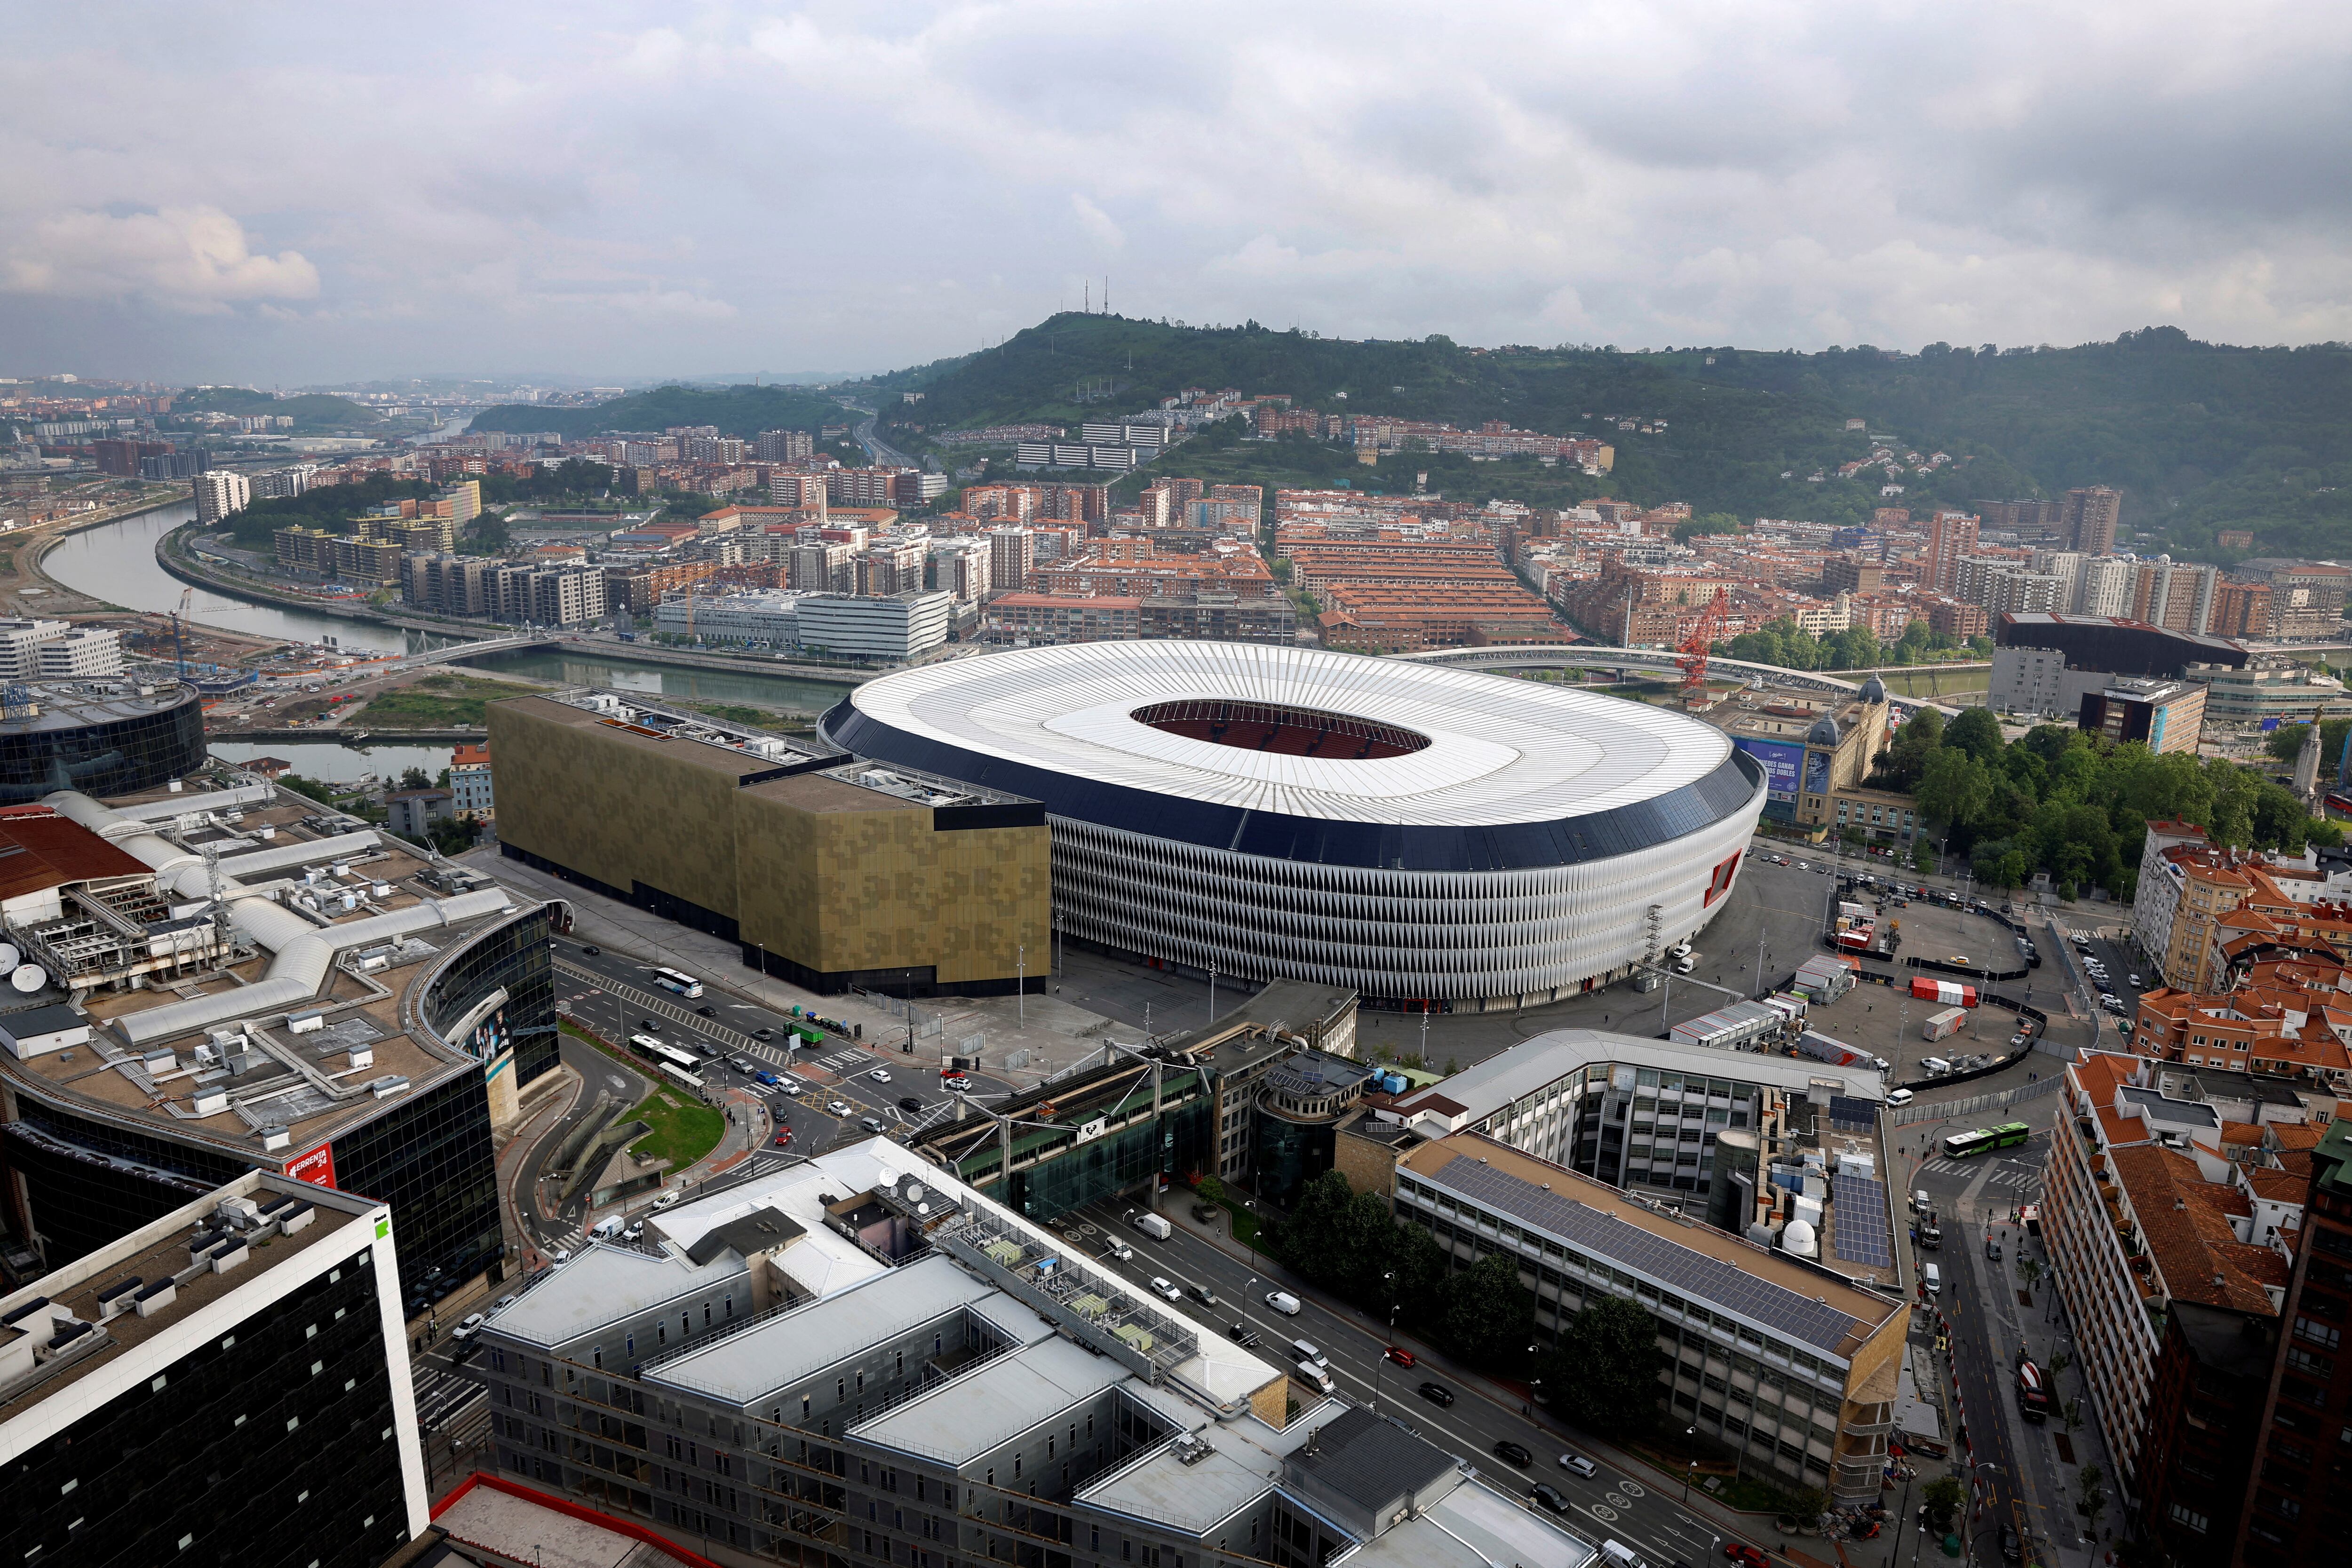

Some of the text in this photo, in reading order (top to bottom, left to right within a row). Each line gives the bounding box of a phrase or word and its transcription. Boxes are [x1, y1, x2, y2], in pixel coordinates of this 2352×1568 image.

[296, 1149, 326, 1171] ERRENTA
[318, 1157, 327, 1168] 24
[296, 1162, 318, 1178] RENTA
[1613, 1496, 1625, 1505] 30
[1598, 1508, 1611, 1518] 30
